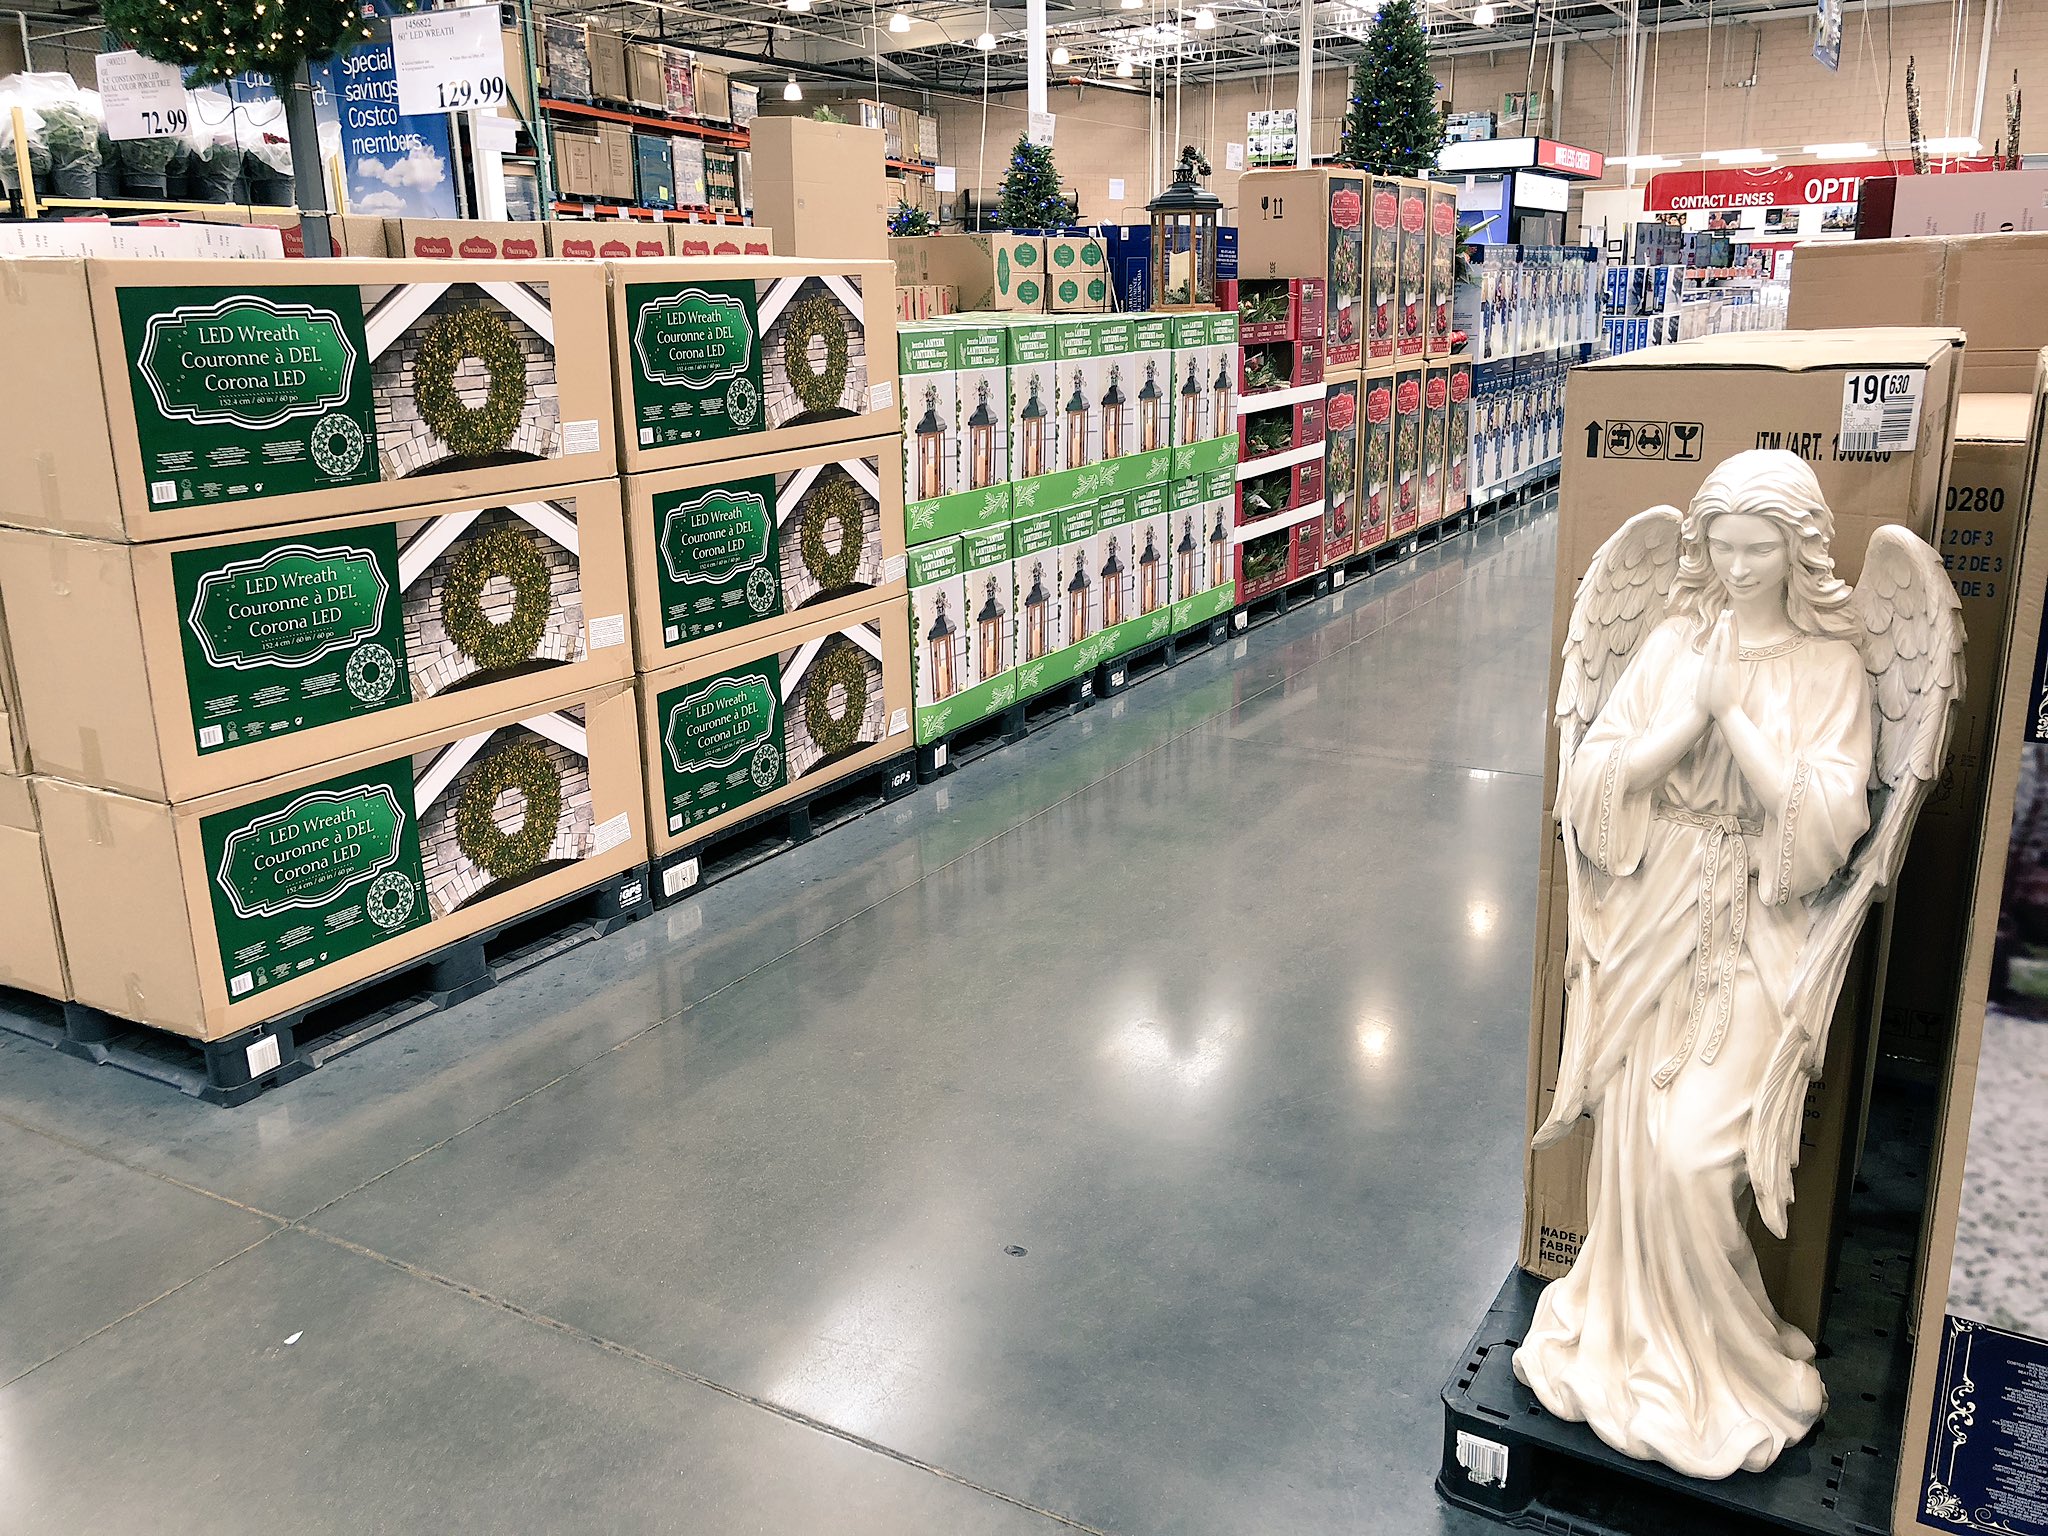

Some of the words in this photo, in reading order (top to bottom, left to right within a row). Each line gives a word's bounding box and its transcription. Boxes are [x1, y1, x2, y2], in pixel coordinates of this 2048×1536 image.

[405, 18, 432, 30] 1456822
[410, 30, 424, 39] LED
[425, 27, 455, 38] WREATH
[342, 47, 392, 79] Special
[345, 77, 398, 104] savings
[437, 76, 504, 109] 129.99
[141, 109, 187, 134] 72.99
[349, 105, 398, 128] Costco
[352, 130, 422, 155] members
[1671, 195, 1724, 209] CONTACT
[1728, 192, 1774, 207] LENSES
[1804, 176, 1860, 203] OPTI
[667, 312, 686, 325] LED
[688, 309, 722, 324] Wreath
[198, 326, 233, 344] LED
[237, 324, 300, 343] Wreath
[657, 330, 705, 344] Couronne
[708, 328, 713, 339] à
[715, 326, 734, 339] DEL
[181, 351, 270, 369] Couronne
[275, 348, 285, 364] à
[289, 346, 322, 363] DEL
[669, 348, 704, 361] Corona
[706, 344, 725, 357] LED
[205, 372, 269, 391] Corona
[273, 370, 306, 388] LED
[1889, 374, 1910, 394] 630
[1945, 487, 2005, 512] 0280
[691, 514, 709, 528] LED
[711, 507, 743, 523] Wreath
[681, 530, 726, 546] Couronne
[729, 525, 734, 537] à
[736, 521, 753, 534] DEL
[1949, 530, 1958, 544] 2
[1961, 530, 1982, 546] OF
[1984, 531, 1993, 546] 3
[693, 545, 725, 560] Corona
[727, 538, 745, 552] LED
[1957, 556, 1967, 571] 2
[1970, 556, 1990, 572] DE
[1994, 558, 2003, 573] 3
[245, 576, 278, 595] LED
[280, 566, 337, 589] Wreath
[1961, 581, 1982, 597] DE
[1986, 583, 1995, 598] 3
[228, 595, 309, 620] Couronne
[314, 590, 322, 604] à
[326, 584, 357, 602] DEL
[249, 616, 308, 638] Corona
[311, 607, 342, 626] LED
[696, 703, 714, 719] LED
[716, 691, 748, 710] Wreath
[686, 714, 732, 737] Couronne
[734, 710, 739, 720] à
[741, 702, 758, 718] DEL
[698, 731, 731, 748] Corona
[733, 720, 750, 735] LED
[891, 771, 911, 788] iGPS
[269, 824, 300, 846] LED
[303, 806, 357, 833] Wreath
[254, 836, 330, 871] Couronne
[334, 830, 343, 844] à
[346, 819, 375, 840] DEL
[274, 857, 329, 885] Corona
[332, 843, 361, 864] LED
[619, 883, 642, 901] iGPS
[1540, 1225, 1577, 1243] MADE
[1540, 1250, 1577, 1266] HECH
